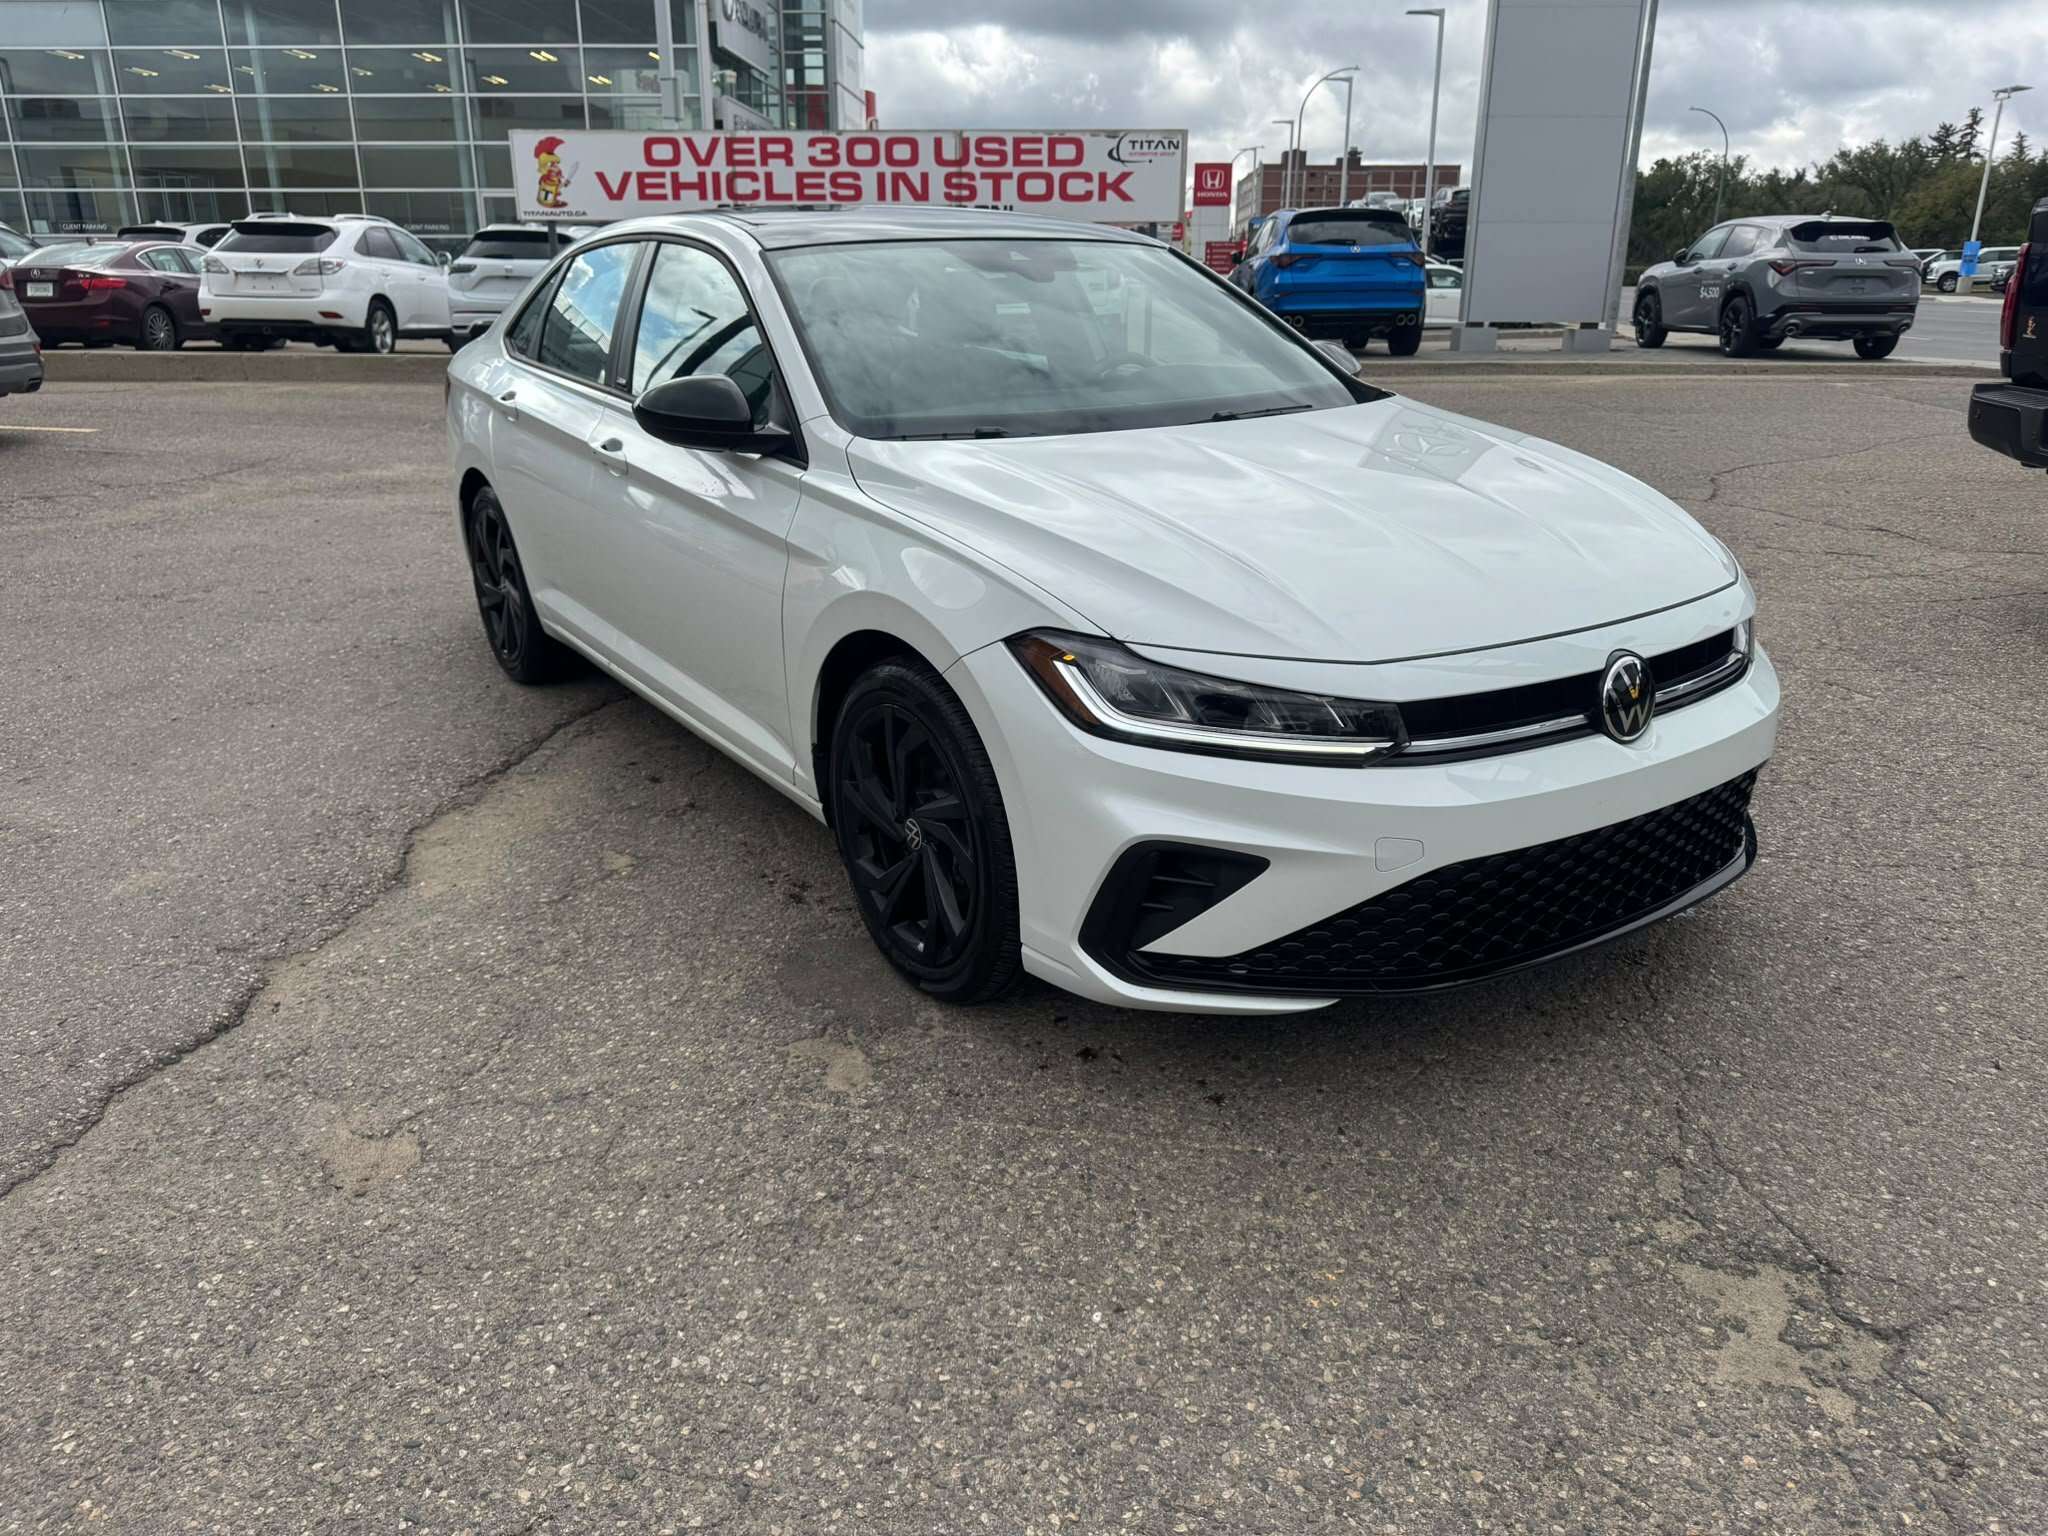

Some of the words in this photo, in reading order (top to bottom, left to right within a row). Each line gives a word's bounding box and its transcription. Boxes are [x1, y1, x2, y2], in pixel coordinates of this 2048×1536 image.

[644, 137, 793, 166] OVER
[810, 137, 918, 166] 300
[934, 137, 1085, 167] USED
[1128, 139, 1180, 151] TITAN
[595, 171, 863, 201] VEHICLES
[877, 172, 929, 200] IN
[943, 172, 1135, 201] STOCK
[1197, 191, 1229, 199] HONDA
